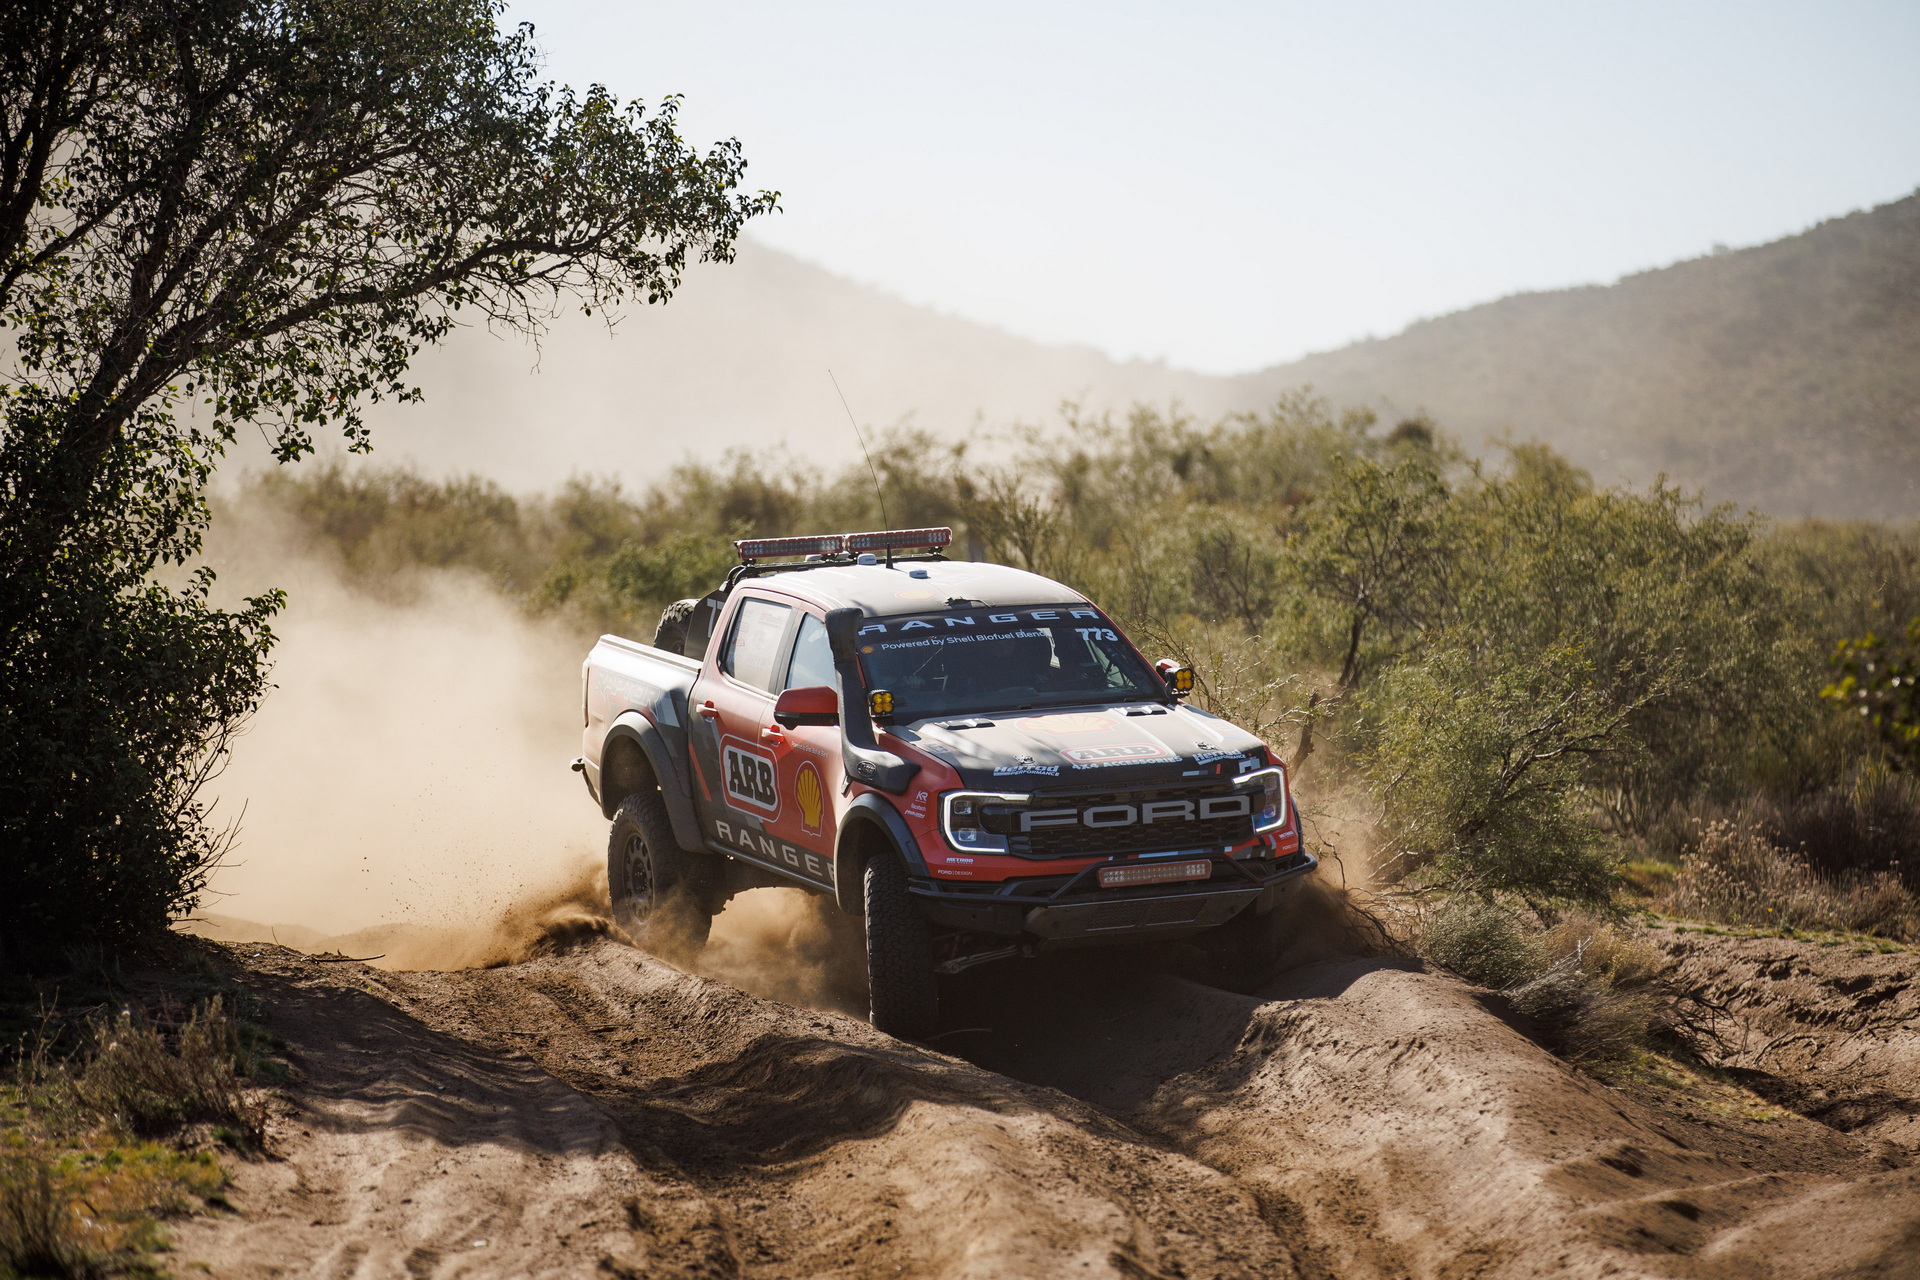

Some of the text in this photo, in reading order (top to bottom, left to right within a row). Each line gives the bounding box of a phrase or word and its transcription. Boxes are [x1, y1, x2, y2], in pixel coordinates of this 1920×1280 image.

[858, 610, 1099, 636] RANGER
[881, 639, 930, 650] Powered
[932, 638, 945, 646] by
[946, 634, 975, 644] Shell
[976, 630, 1016, 641] Biofuel
[1075, 628, 1118, 641] 773
[1075, 746, 1157, 760] ARB
[1103, 756, 1183, 768] ACCESSORIES
[728, 750, 776, 805] ARB
[1020, 795, 1250, 832] FORD
